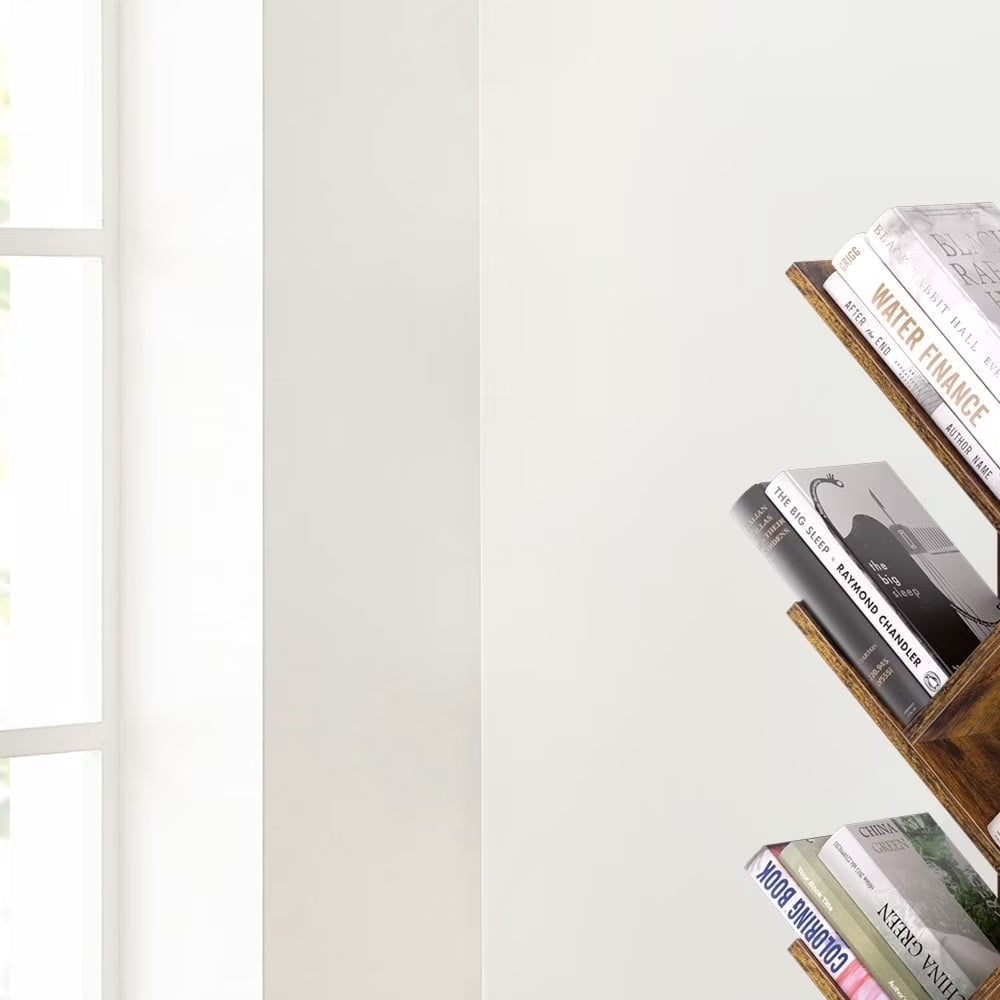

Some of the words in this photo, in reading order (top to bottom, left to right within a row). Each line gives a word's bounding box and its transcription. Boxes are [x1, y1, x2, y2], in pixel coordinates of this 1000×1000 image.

[844, 300, 866, 327] AFTER
[864, 329, 875, 340] the
[874, 336, 892, 357] END
[949, 316, 977, 352] HALL
[871, 282, 924, 351] WATER
[918, 343, 989, 427] FINANCE
[945, 423, 972, 455] AUTHOR
[972, 454, 993, 480] NAME
[773, 486, 792, 507] THE
[789, 506, 808, 528] BIG
[804, 525, 830, 554] SLEEP
[835, 563, 880, 616] RAYMOND
[878, 615, 922, 669] CHANDLER
[869, 560, 888, 572] the
[879, 575, 902, 588] big
[892, 585, 921, 600] sleep
[859, 822, 897, 839] CHINA
[872, 838, 909, 854] GREEN
[756, 860, 797, 909] BOOK
[795, 865, 810, 882] Your
[806, 880, 823, 898] Book
[787, 898, 848, 973] COLORING
[877, 902, 923, 957] GREEN
